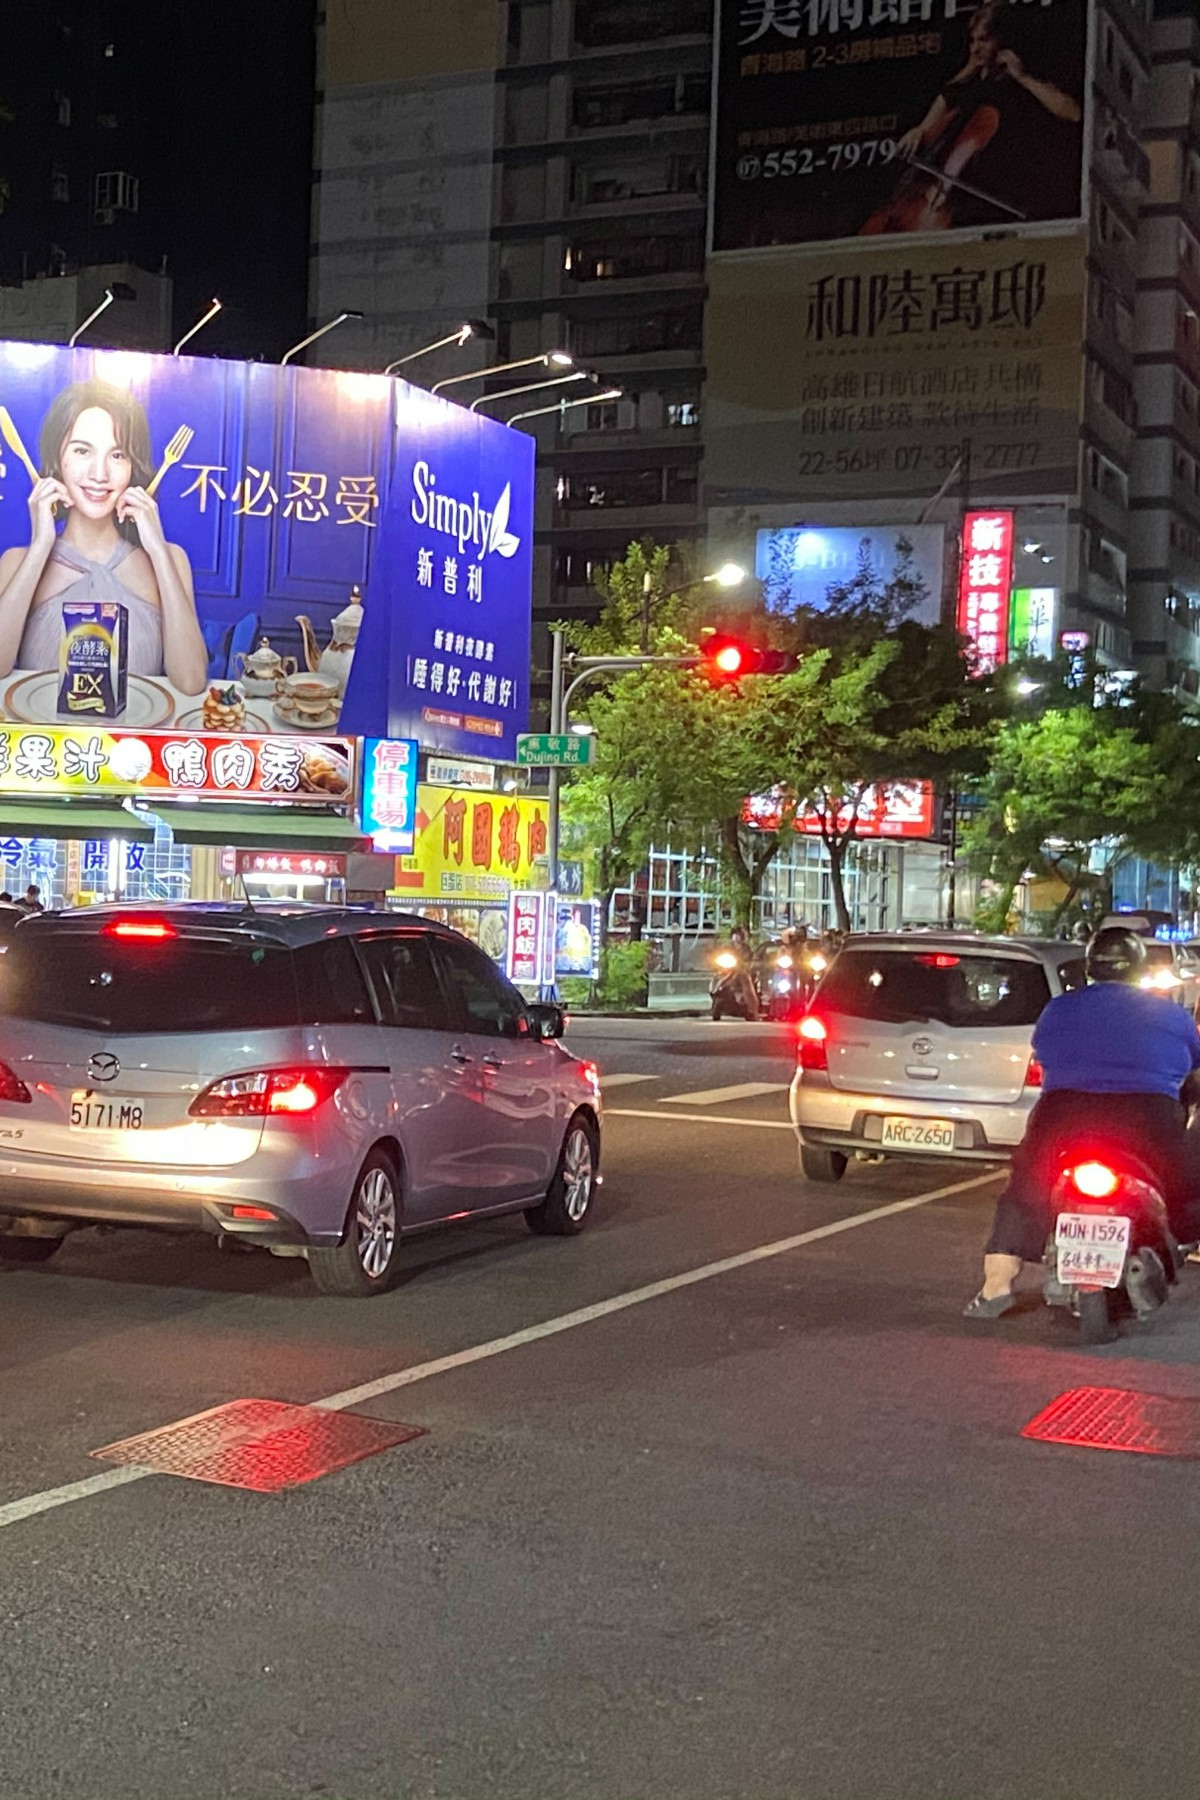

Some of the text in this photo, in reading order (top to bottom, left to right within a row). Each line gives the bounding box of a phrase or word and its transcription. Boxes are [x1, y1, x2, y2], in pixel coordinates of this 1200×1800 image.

[762, 138, 897, 178] 552-7979
[805, 261, 1047, 341] 和陸寓邸
[894, 442, 1040, 472] 07-33-2777
[180, 463, 379, 528] 不必忍受
[411, 460, 493, 561] Simply
[416, 546, 483, 604] 新普利
[163, 740, 302, 792] 鴨肉秀
[373, 741, 409, 828] 停車場
[526, 751, 581, 765] Dujing Rd.
[442, 797, 548, 874] 阿國鵝肉
